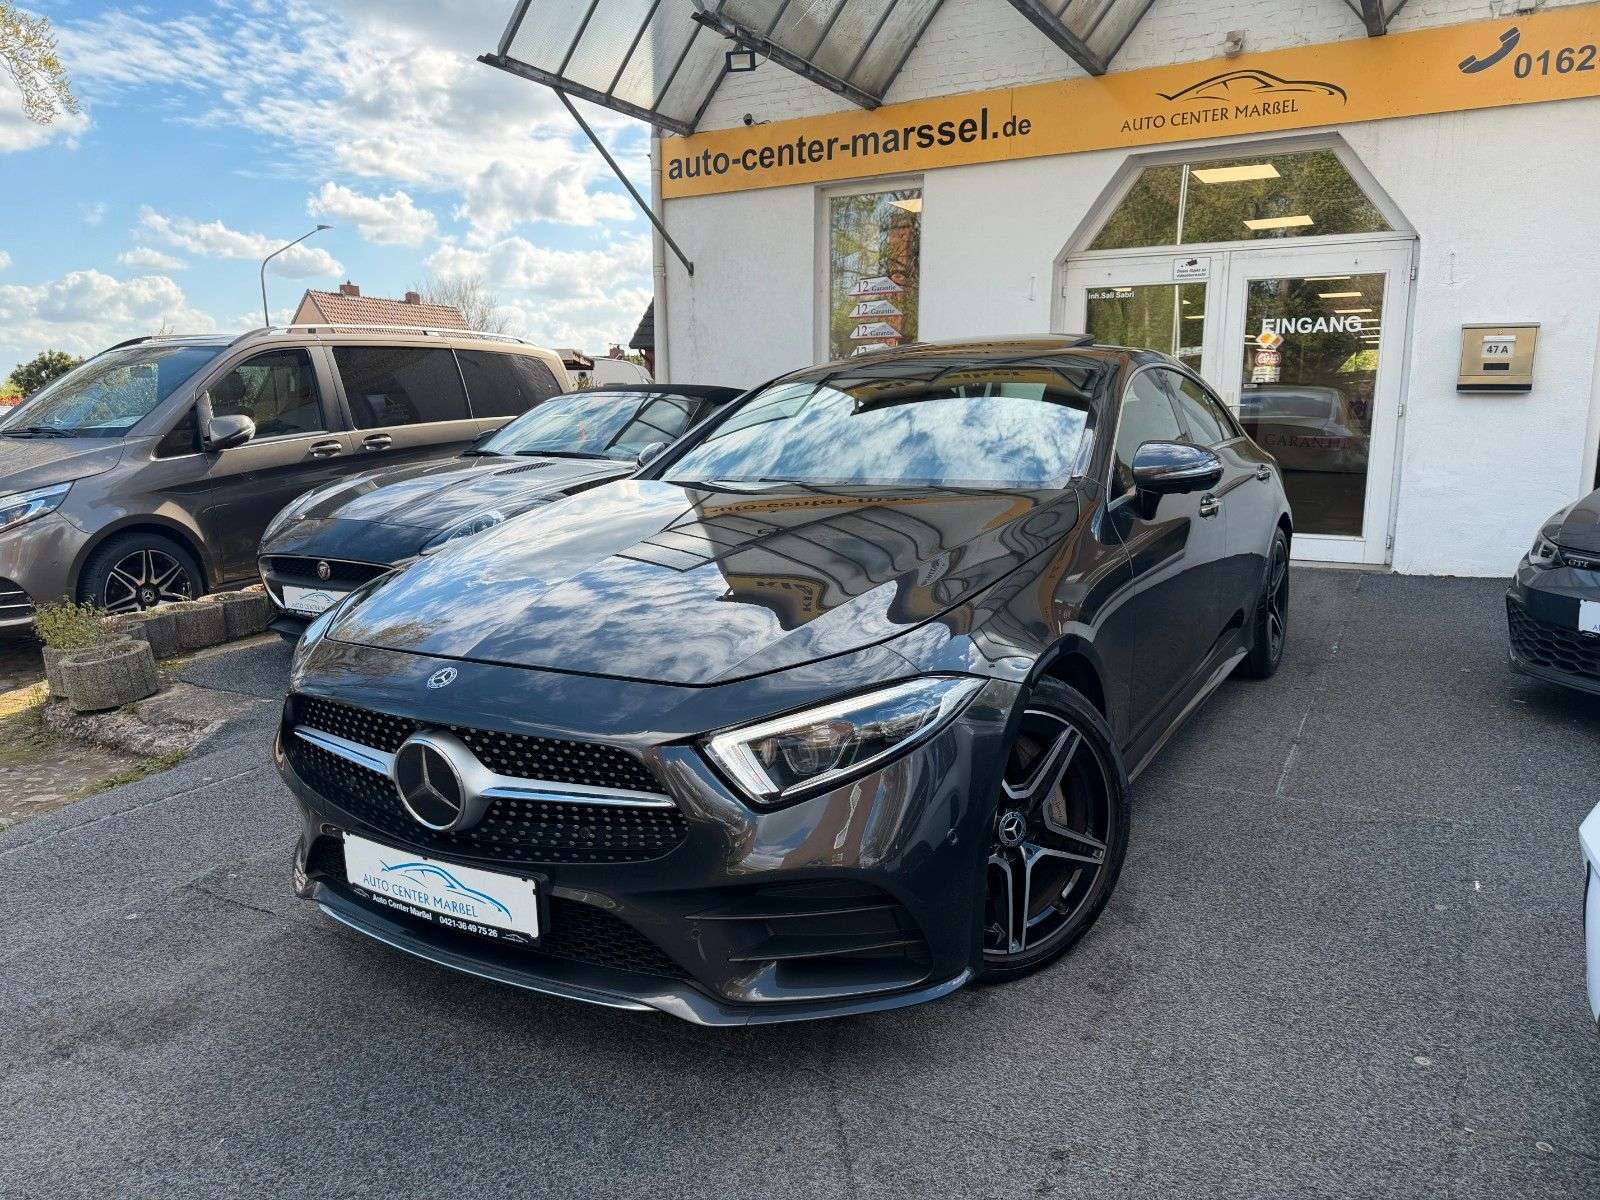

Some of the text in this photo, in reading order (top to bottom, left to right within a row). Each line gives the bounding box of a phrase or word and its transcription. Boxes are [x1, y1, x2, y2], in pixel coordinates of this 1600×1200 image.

[1513, 44, 1597, 79] 0162
[1120, 115, 1166, 132] AUTO
[1170, 107, 1229, 127] CENTER
[668, 107, 1033, 180] auto-center-marssel.de
[857, 280, 869, 293] 12
[856, 303, 868, 315] 12
[856, 325, 868, 337] 12
[1261, 315, 1362, 335] EINGANG
[1486, 345, 1509, 354] 47 A
[1568, 559, 1589, 568] GTI
[363, 873, 390, 892] AUTO
[392, 884, 431, 906] CENTER
[372, 894, 388, 905] Auto
[388, 899, 410, 913] Center
[478, 926, 488, 936] 75
